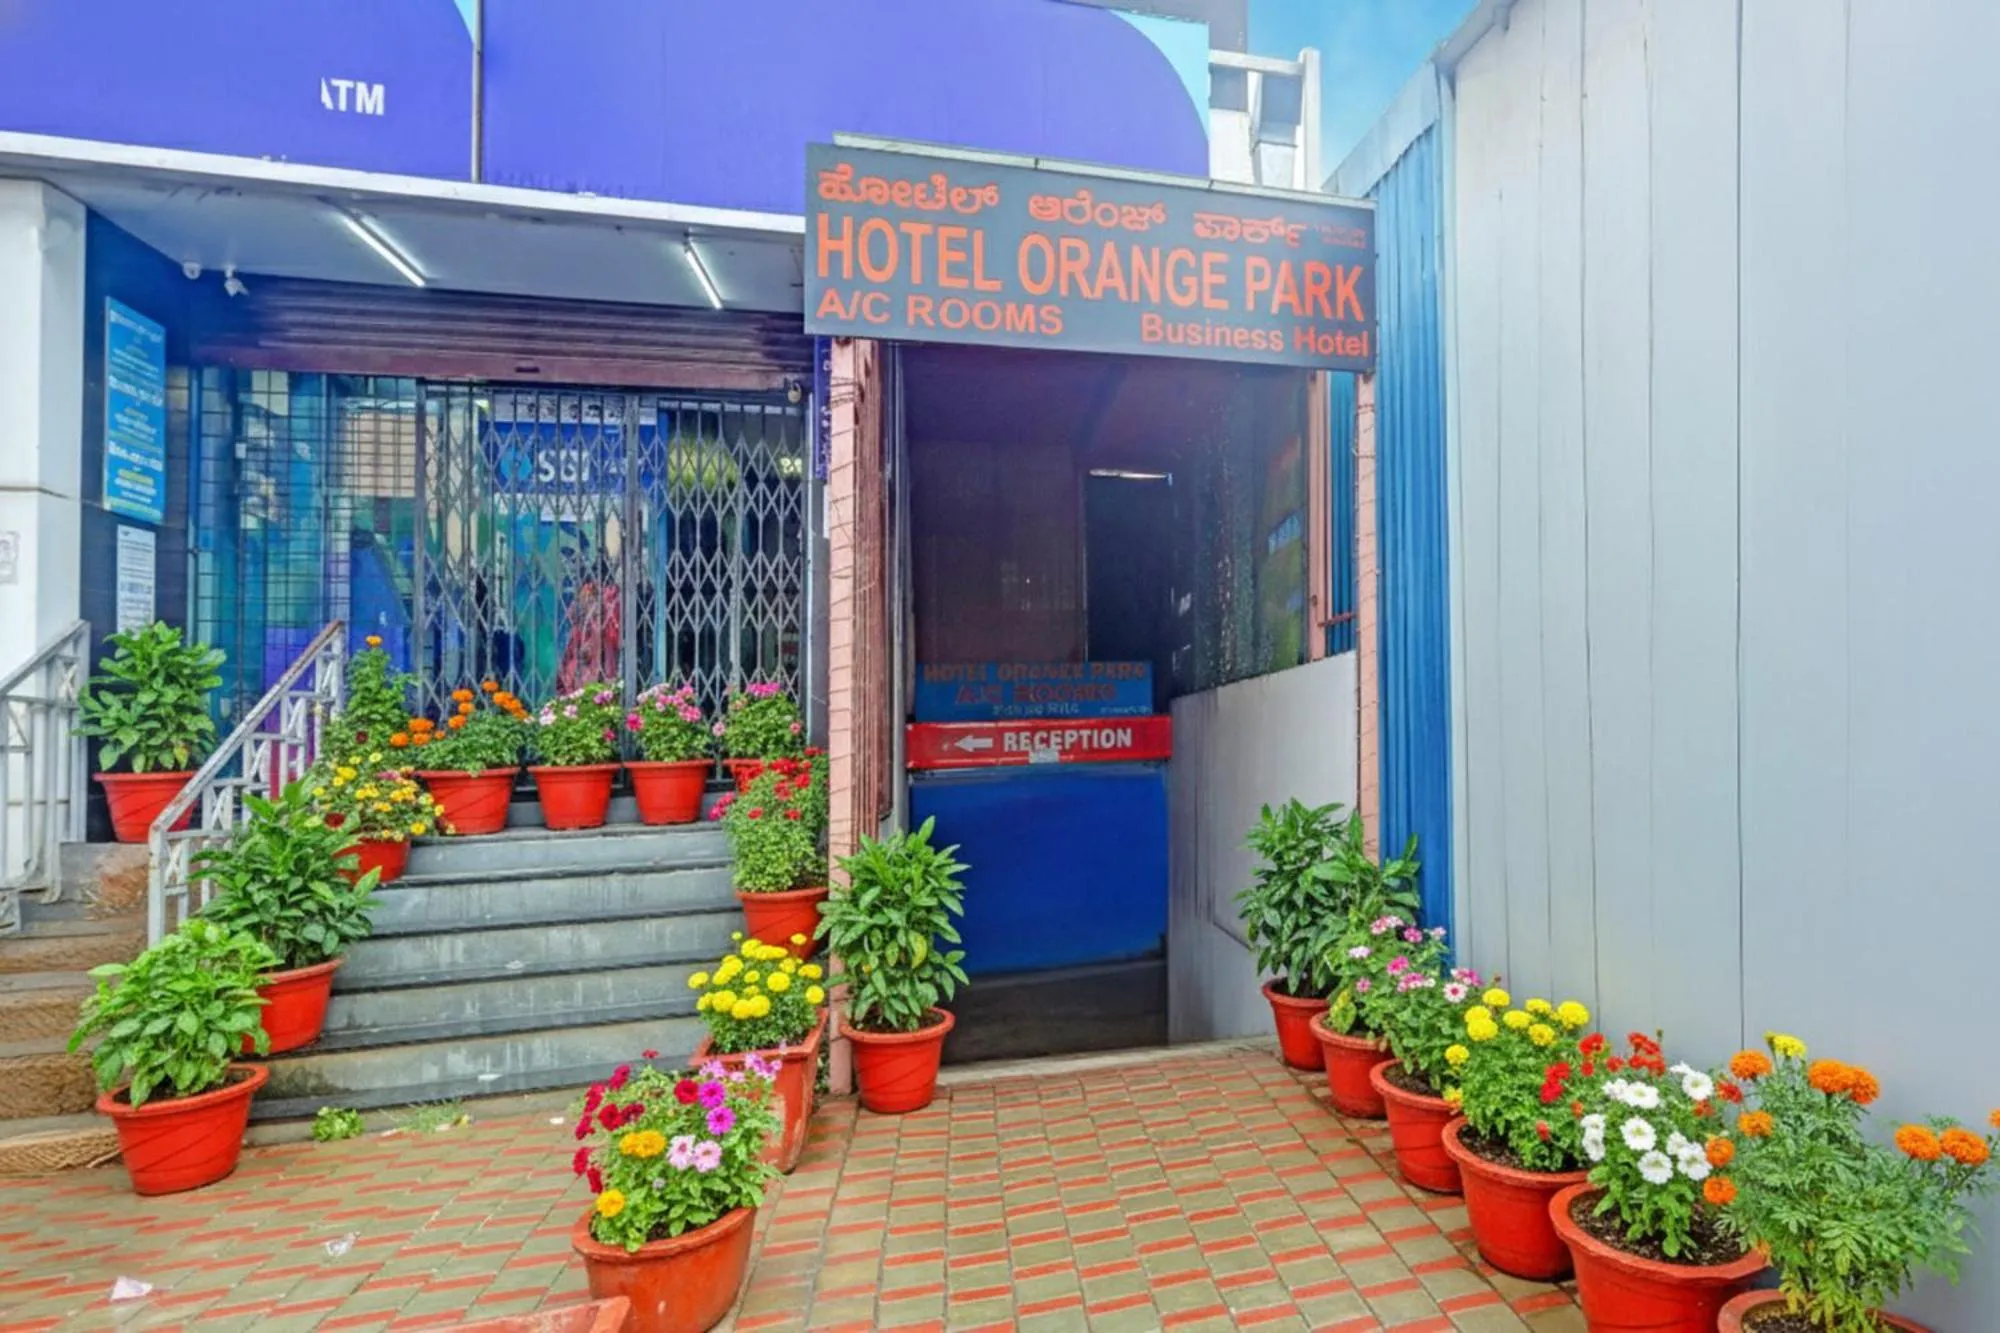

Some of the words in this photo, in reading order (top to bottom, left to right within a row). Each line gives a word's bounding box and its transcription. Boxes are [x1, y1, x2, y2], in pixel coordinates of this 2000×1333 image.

[817, 213, 1003, 292] HOTEL
[1018, 233, 1229, 310] ORANGE
[1245, 256, 1365, 322] PARK
[816, 288, 891, 324] A/C
[907, 295, 1064, 336] ROOMS
[1141, 313, 1285, 352] Business
[1294, 326, 1369, 357] Hotel
[1004, 728, 1132, 752] RECEPTION
